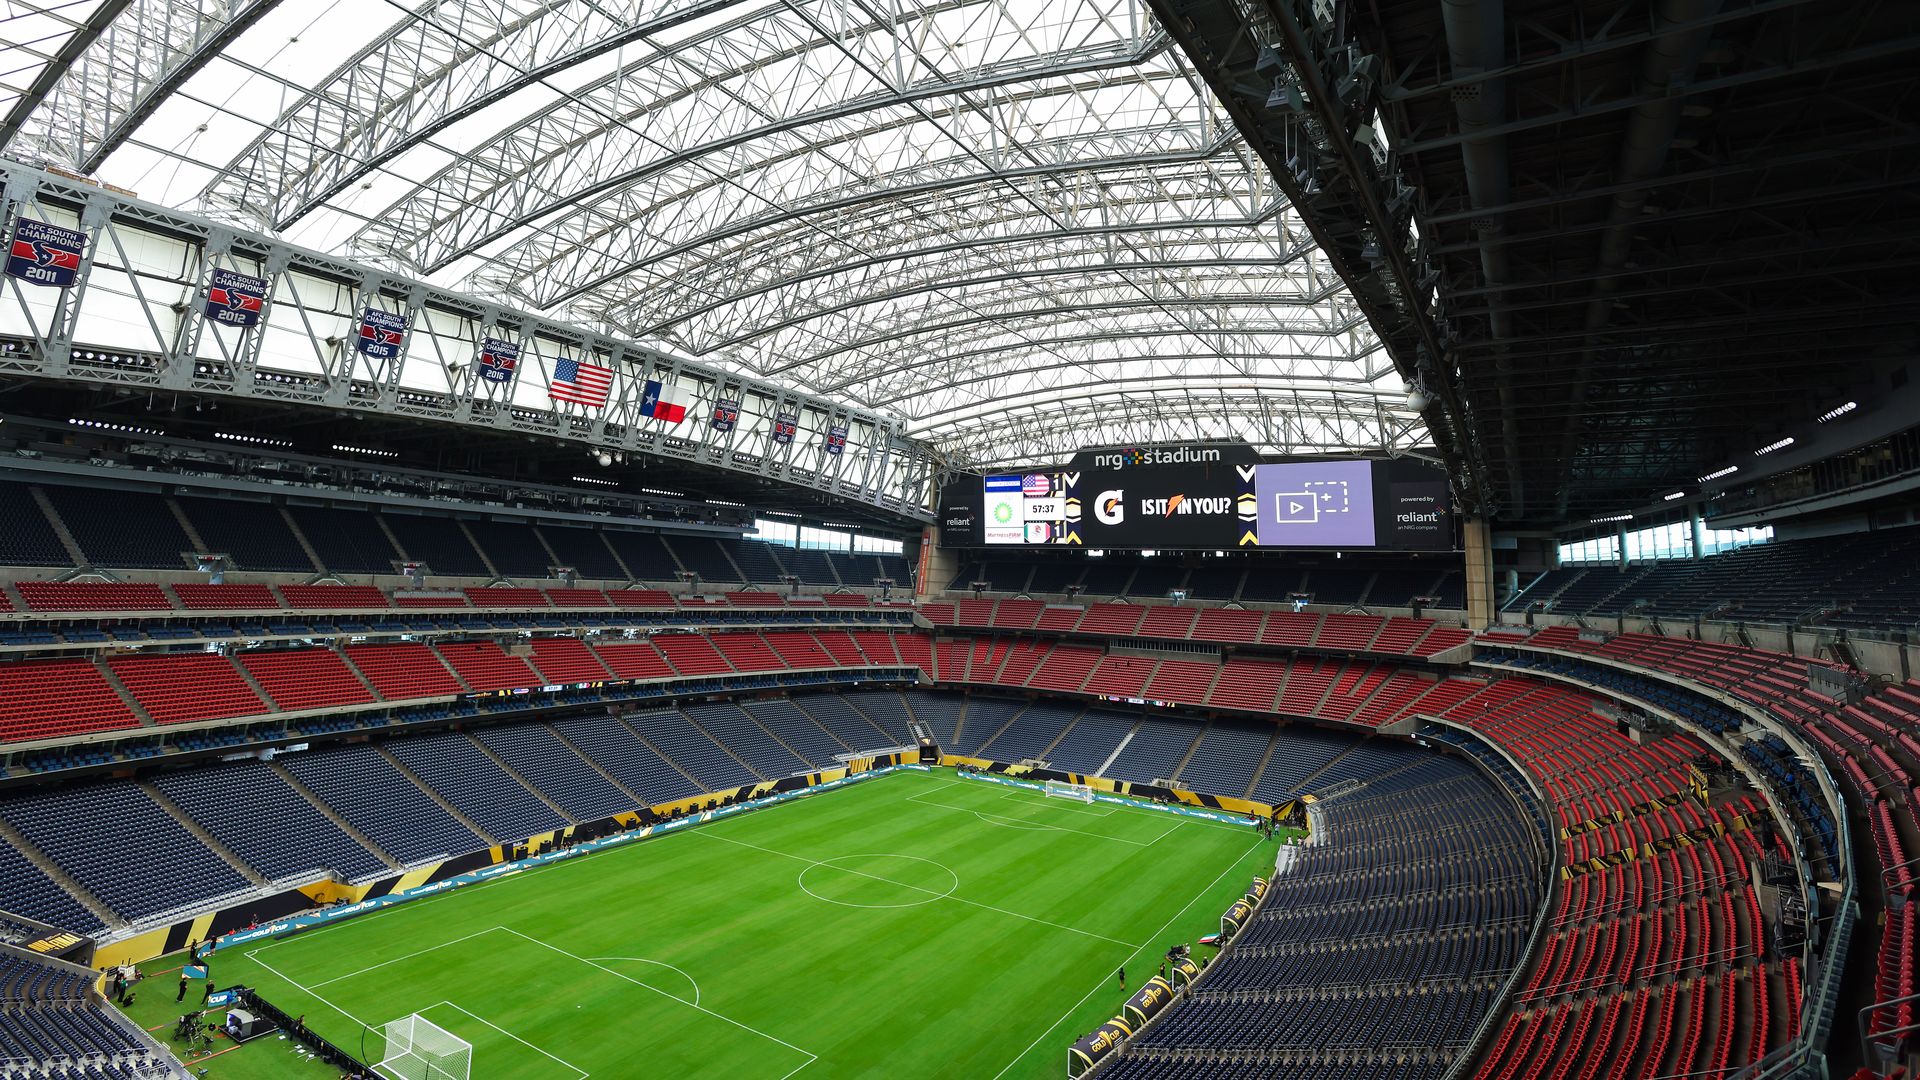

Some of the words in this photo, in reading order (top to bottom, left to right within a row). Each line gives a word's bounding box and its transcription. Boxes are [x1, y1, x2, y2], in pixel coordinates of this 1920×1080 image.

[28, 223, 46, 232] AFC
[48, 228, 77, 240] SOUTH
[18, 228, 82, 249] CHAMPIONS
[25, 266, 57, 282] 2011
[215, 277, 264, 293] CHAMPIONS
[238, 276, 260, 286] SOUTH
[218, 309, 246, 324] 2012
[366, 315, 404, 329] CHAMPIONS
[383, 314, 401, 322] SOUTH
[366, 344, 389, 356] 2015
[486, 370, 504, 380] 2016
[1095, 454, 1123, 470] nrg
[1144, 447, 1220, 464] stadium
[1053, 478, 1059, 490] 1
[1032, 505, 1054, 513] 57:37
[1142, 499, 1154, 515] IS
[1154, 499, 1168, 515] IT
[1177, 499, 1191, 514] IN
[1192, 498, 1231, 514] YOU?
[1397, 512, 1438, 522] reliant
[1055, 525, 1060, 537] 1
[252, 929, 270, 937] GOLD
[210, 995, 228, 1003] CUP
[1110, 1030, 1120, 1040] CUP
[1092, 1040, 1106, 1052] GOLD
